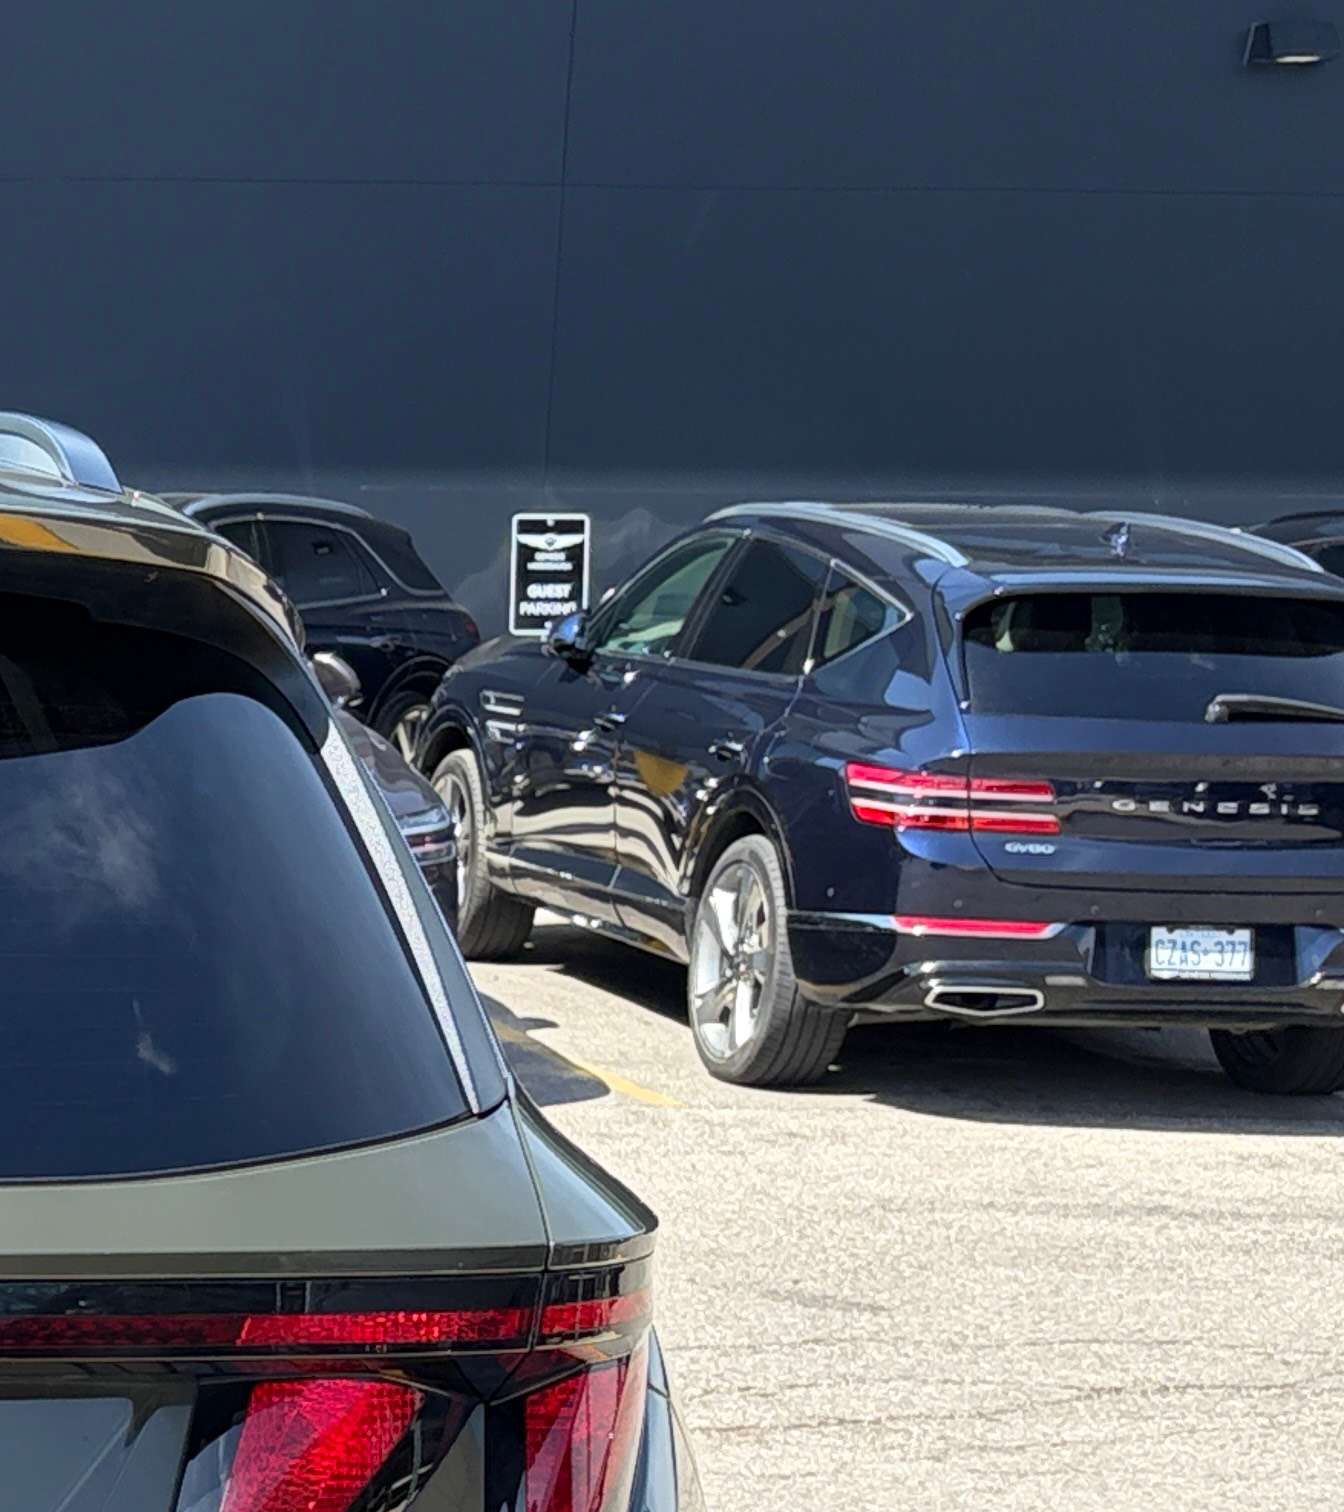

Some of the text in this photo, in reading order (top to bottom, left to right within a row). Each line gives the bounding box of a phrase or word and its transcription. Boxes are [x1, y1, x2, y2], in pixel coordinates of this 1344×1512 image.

[525, 583, 573, 599] GUEST
[1154, 938, 1250, 968] CZAS 377
